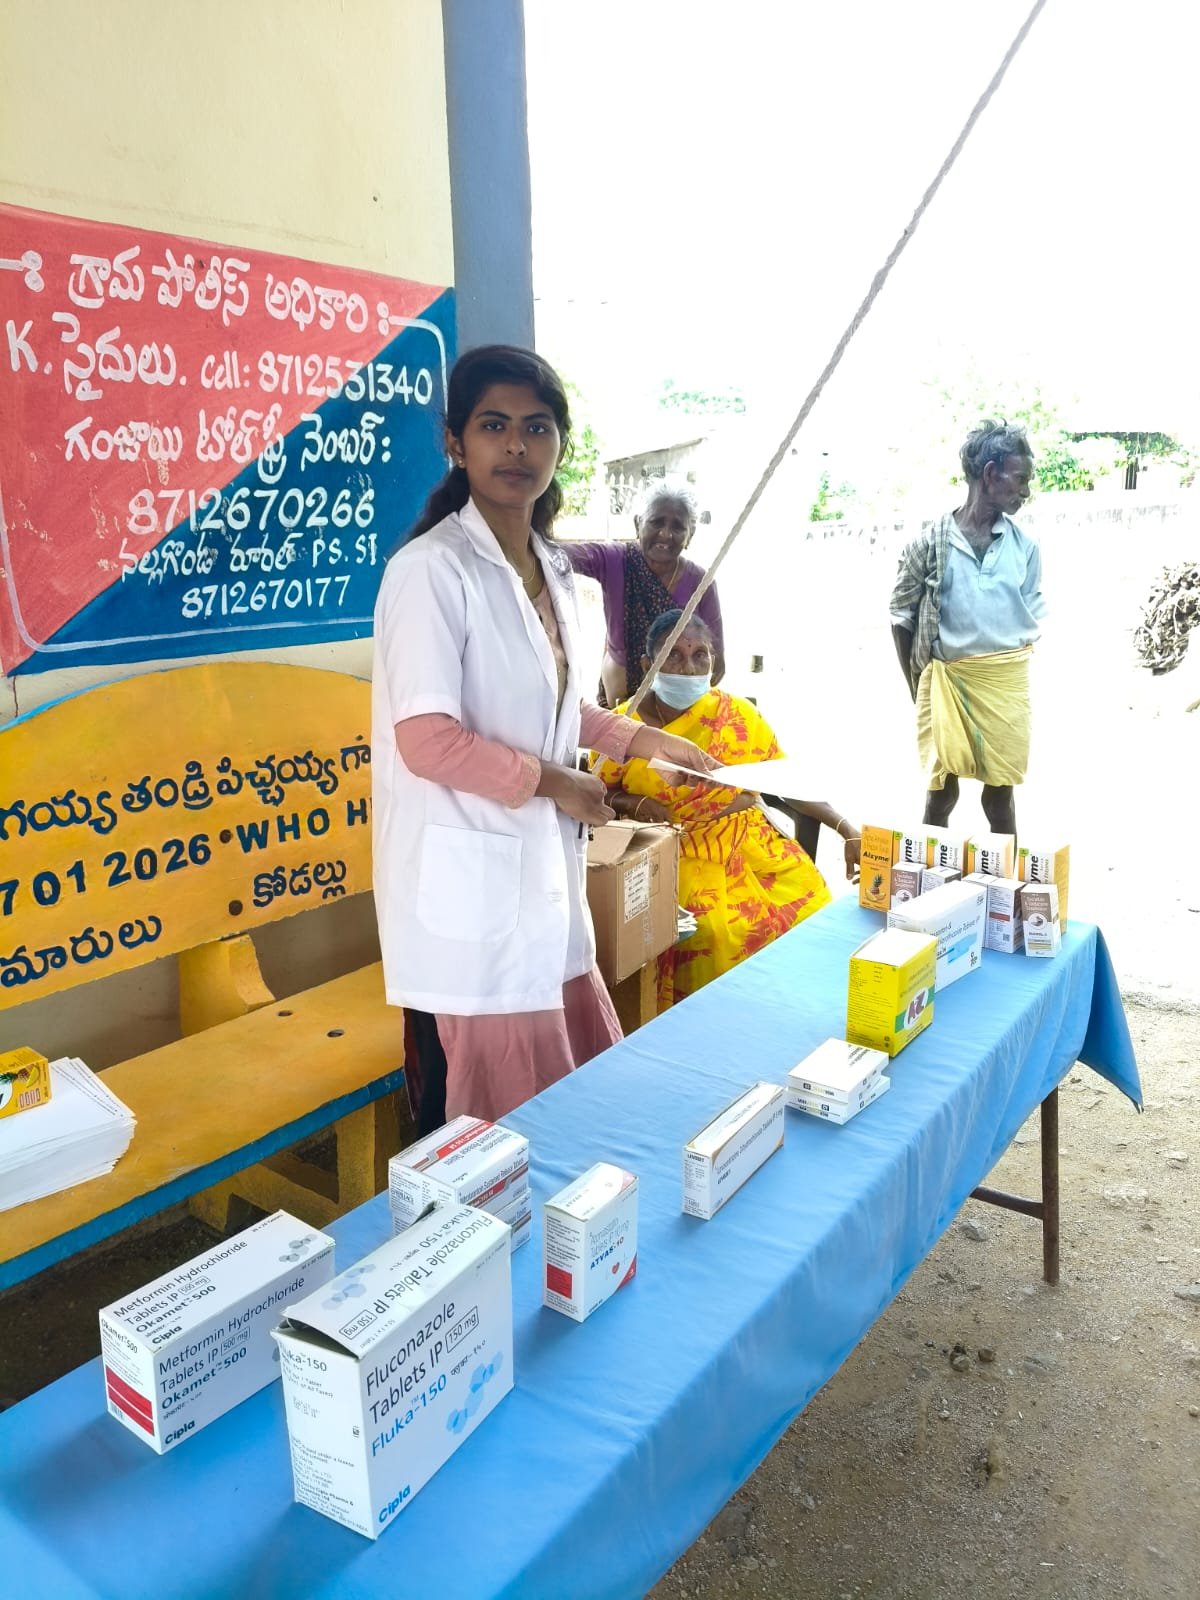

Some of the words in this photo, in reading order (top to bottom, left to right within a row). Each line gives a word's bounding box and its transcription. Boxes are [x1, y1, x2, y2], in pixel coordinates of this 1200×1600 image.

[68, 245, 145, 309] గ్రామ
[258, 350, 433, 406] 8712531340
[128, 486, 376, 536] 8712670266
[181, 574, 352, 619] 8712670177
[103, 834, 212, 888] 2026
[236, 808, 330, 854] WHO
[430, 1215, 493, 1267] Fluconazole
[113, 1280, 176, 1319] Metformin
[174, 1240, 248, 1284] Hydrochloride
[384, 1265, 432, 1302] Tablets
[124, 1300, 168, 1326] Tablets
[170, 1292, 179, 1303] IP
[159, 1327, 225, 1376] Metformin
[228, 1277, 305, 1330] Hydrochloride
[373, 1298, 390, 1314] IP
[152, 1325, 183, 1344] Cipla
[366, 1302, 455, 1397] Fluconazole
[159, 1360, 204, 1394] Tablets
[208, 1348, 220, 1366] IP
[369, 1362, 426, 1425] Tablets
[430, 1342, 444, 1369] IP
[448, 1324, 464, 1345] 150
[464, 1312, 477, 1331] mg
[164, 1420, 196, 1446] Cipla
[378, 1485, 411, 1524] Cipla
